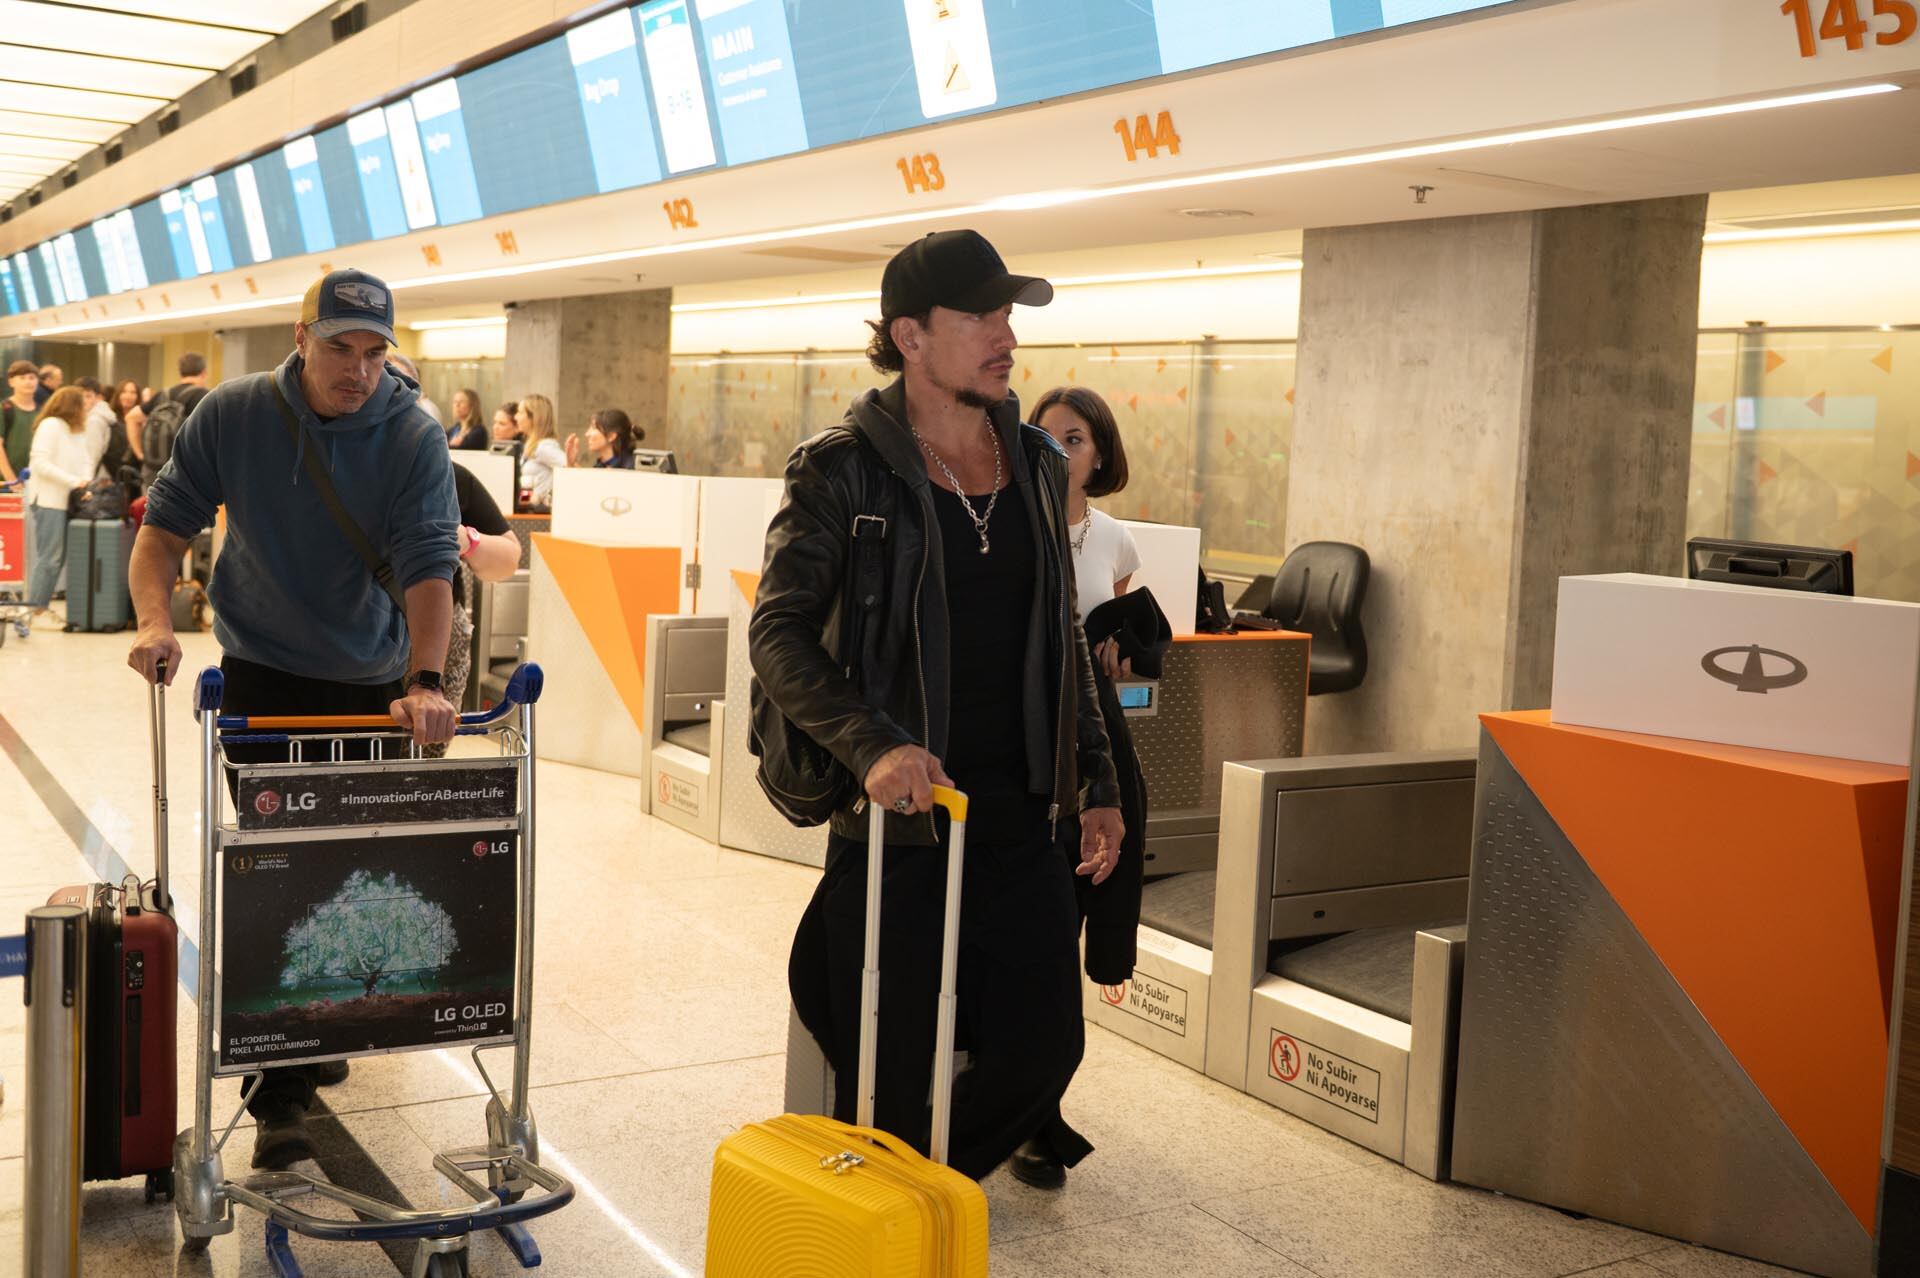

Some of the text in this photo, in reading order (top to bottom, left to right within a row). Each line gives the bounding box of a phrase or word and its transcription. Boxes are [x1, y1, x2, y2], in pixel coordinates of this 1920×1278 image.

[711, 25, 754, 60] MAIN
[1779, 0, 1918, 58] 145
[1113, 109, 1182, 162] 144
[896, 152, 946, 194] 143
[663, 197, 698, 231] 142
[286, 787, 505, 811] LG #InnovationForABetterLife
[491, 841, 510, 854] LG
[1131, 978, 1170, 1005] No Subir
[434, 1002, 506, 1023] LG OLED
[1130, 993, 1185, 1027] Ni Apoyarse
[229, 1038, 320, 1055] PIXEL AUTOLUMINOSO
[230, 1033, 287, 1046] EL PODER DEL
[1307, 1052, 1357, 1085] No Subir
[1306, 1069, 1377, 1112] Ni Apoyarse
